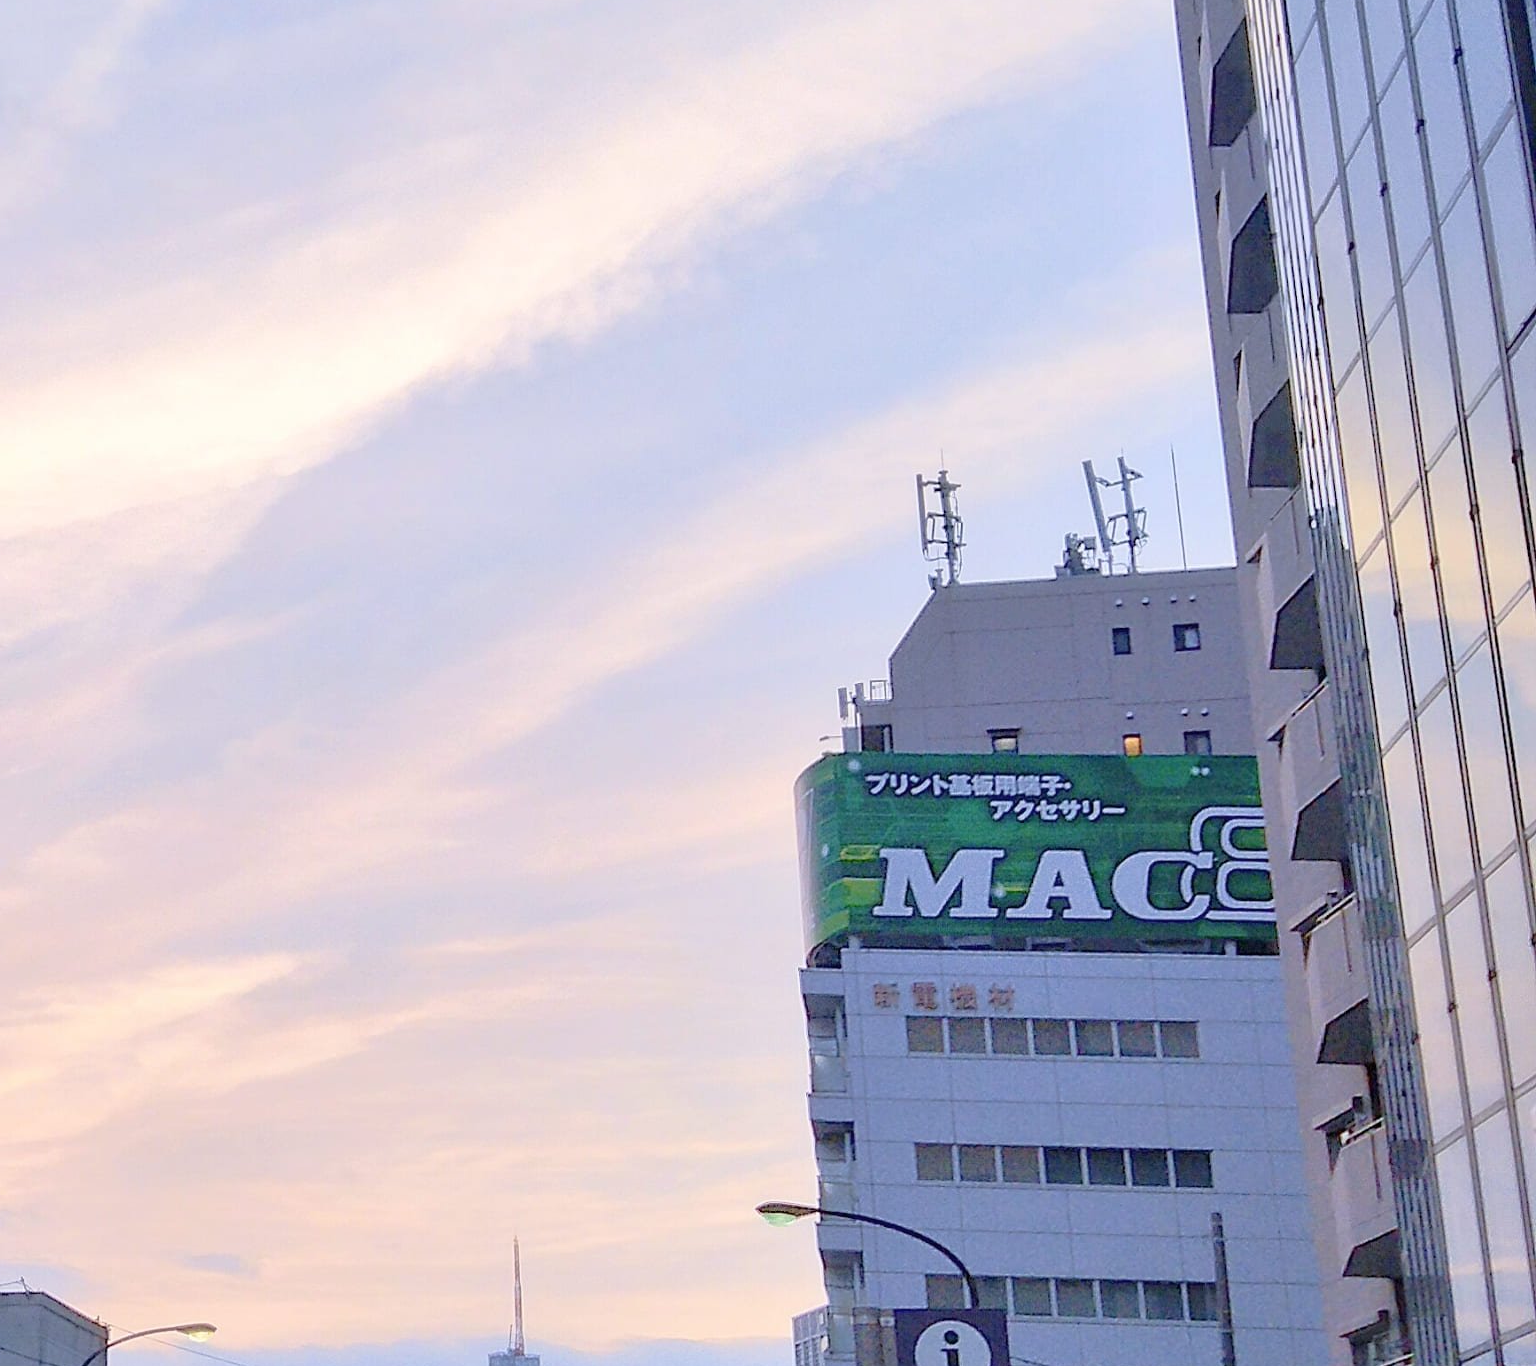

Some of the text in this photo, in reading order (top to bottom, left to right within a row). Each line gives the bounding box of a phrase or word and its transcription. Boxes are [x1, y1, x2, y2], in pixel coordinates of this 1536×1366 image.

[989, 799, 1126, 822] アクセサリー
